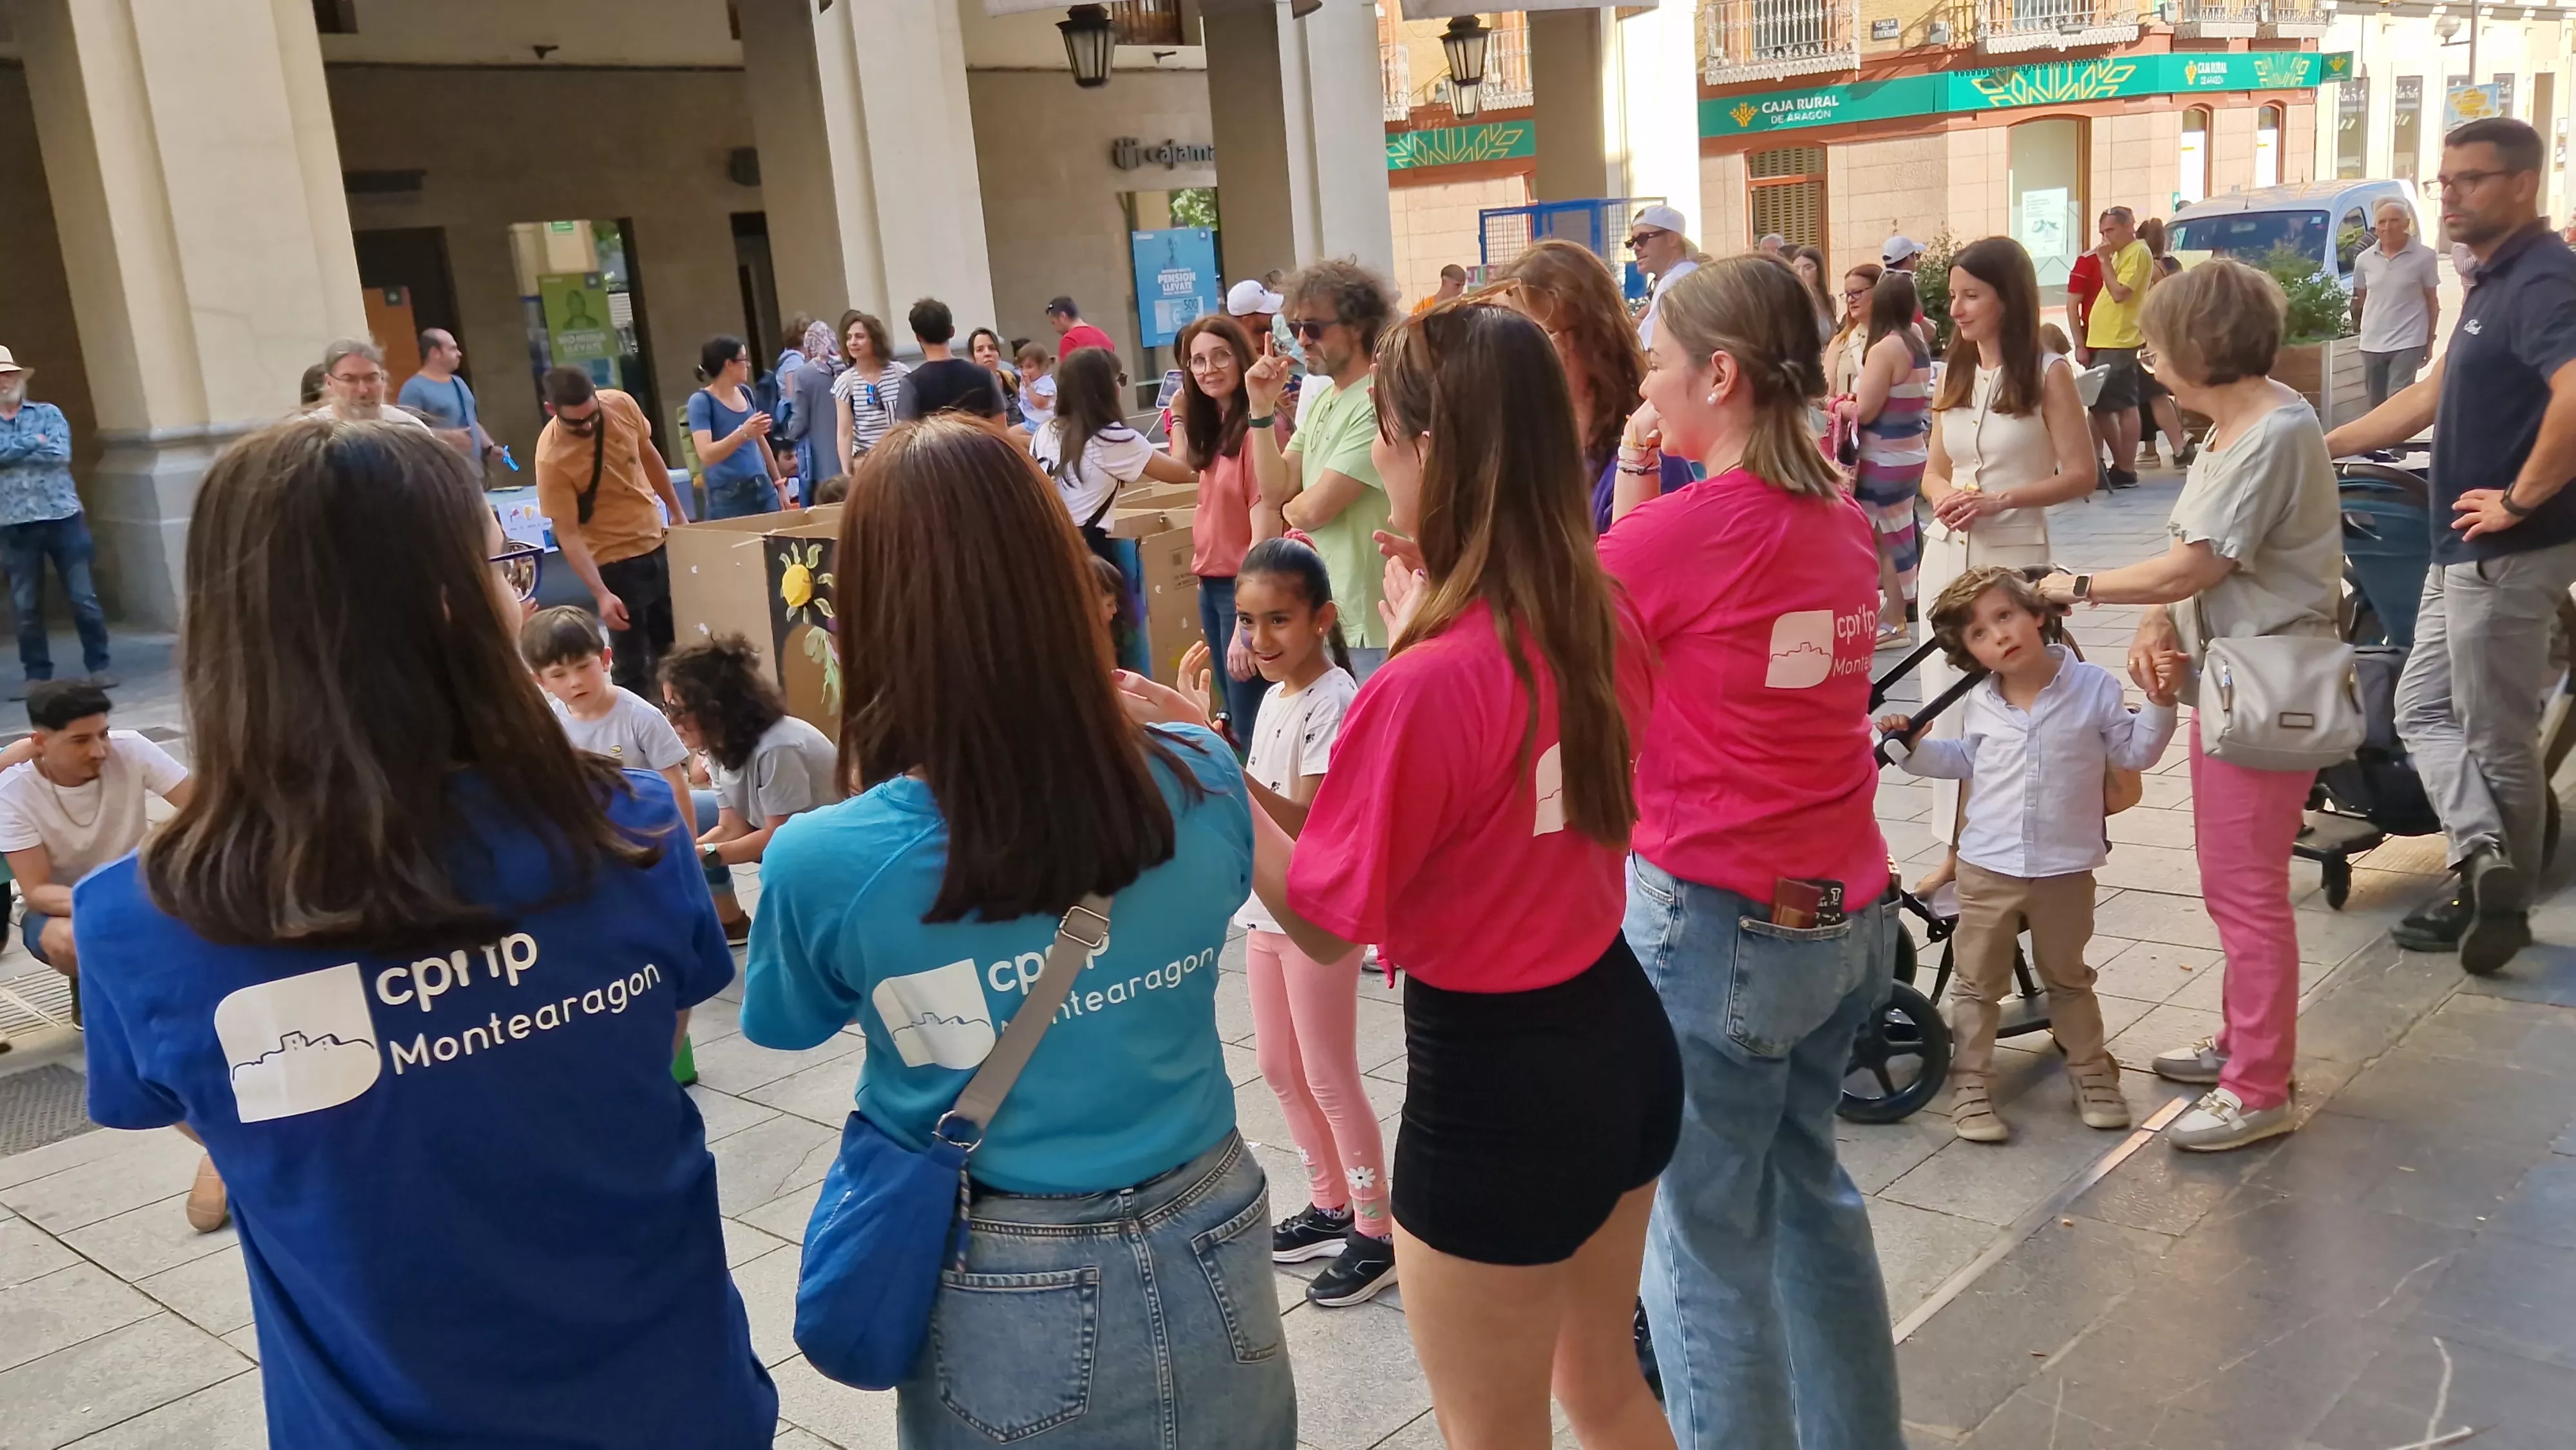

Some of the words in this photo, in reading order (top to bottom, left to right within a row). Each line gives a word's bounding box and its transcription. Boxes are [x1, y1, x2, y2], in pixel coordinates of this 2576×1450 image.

[1761, 100, 1794, 113] CAJA
[1797, 95, 1839, 109] RURAL
[1771, 115, 1784, 124] DE
[1786, 109, 1832, 122] ARAGÓN
[1184, 299, 1198, 310] 500
[388, 963, 661, 1075] Montearagon
